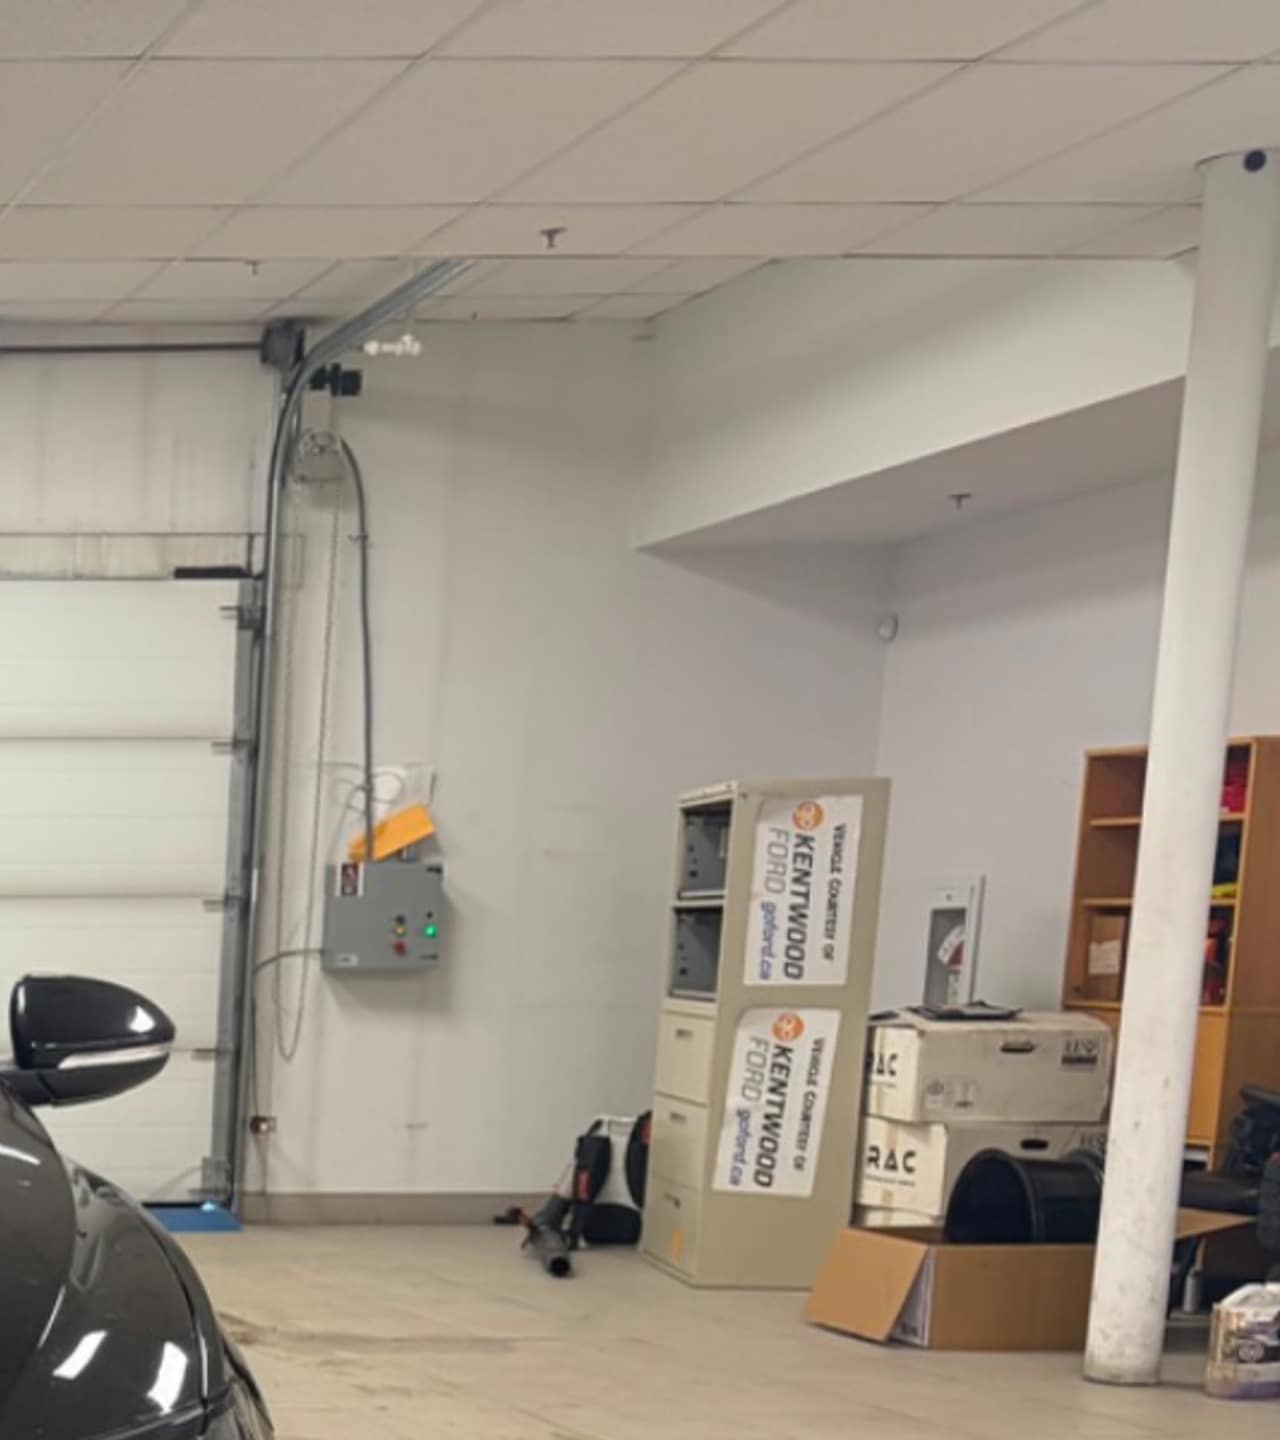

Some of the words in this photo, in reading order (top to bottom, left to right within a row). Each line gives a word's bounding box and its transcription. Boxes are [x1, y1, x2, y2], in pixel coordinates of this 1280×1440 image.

[764, 827, 790, 894] FORD
[759, 901, 779, 981] goford.ca
[783, 833, 815, 980] KENTWOOD
[742, 1035, 769, 1102] FORD
[729, 1108, 752, 1186] goford.ca
[753, 1044, 793, 1188] KENTWOOD
[866, 1145, 917, 1174] RAC
